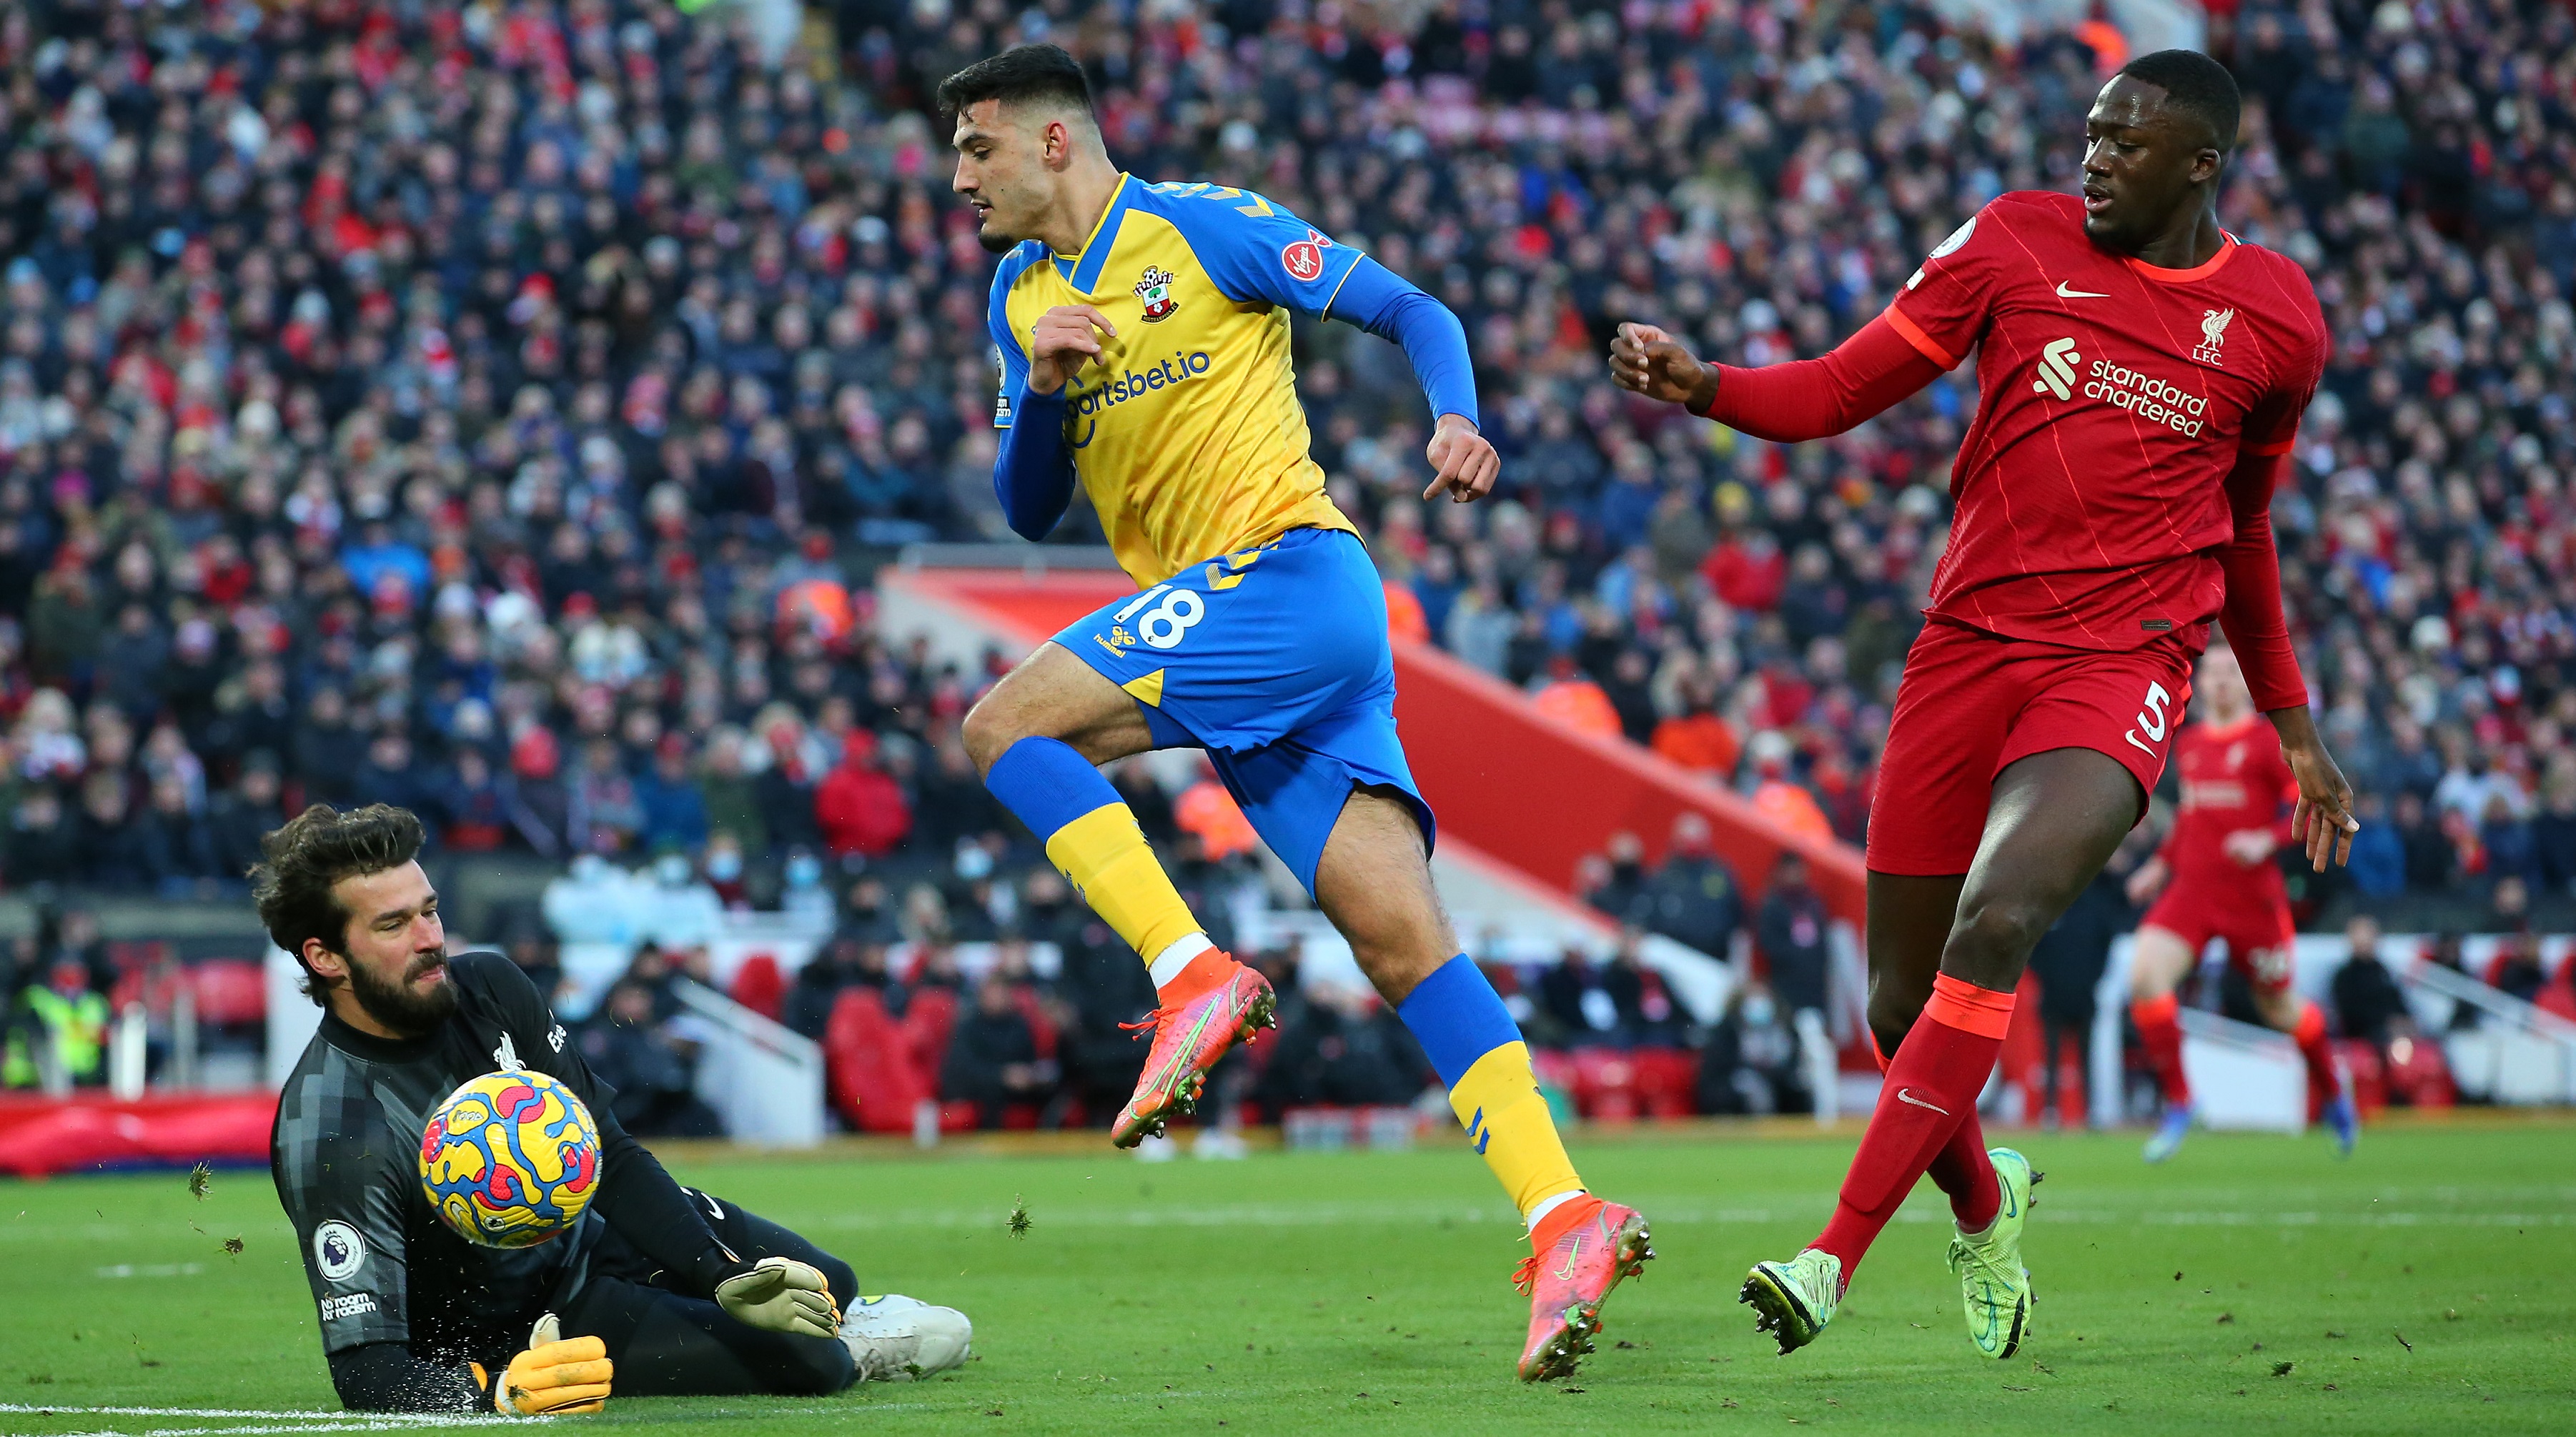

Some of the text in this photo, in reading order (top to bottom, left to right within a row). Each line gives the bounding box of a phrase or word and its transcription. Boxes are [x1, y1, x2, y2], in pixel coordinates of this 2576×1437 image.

[1289, 246, 1317, 274] Virgin
[2191, 348, 2224, 367] L.F.C.
[1066, 351, 1210, 427] portsbet.io
[2084, 380, 2204, 438] chartered
[2089, 359, 2208, 417] standard
[1112, 583, 1205, 650] 18
[1093, 633, 1126, 659] hummel
[2136, 680, 2171, 742] 5
[320, 1293, 370, 1311] No room
[335, 1301, 377, 1318] racism
